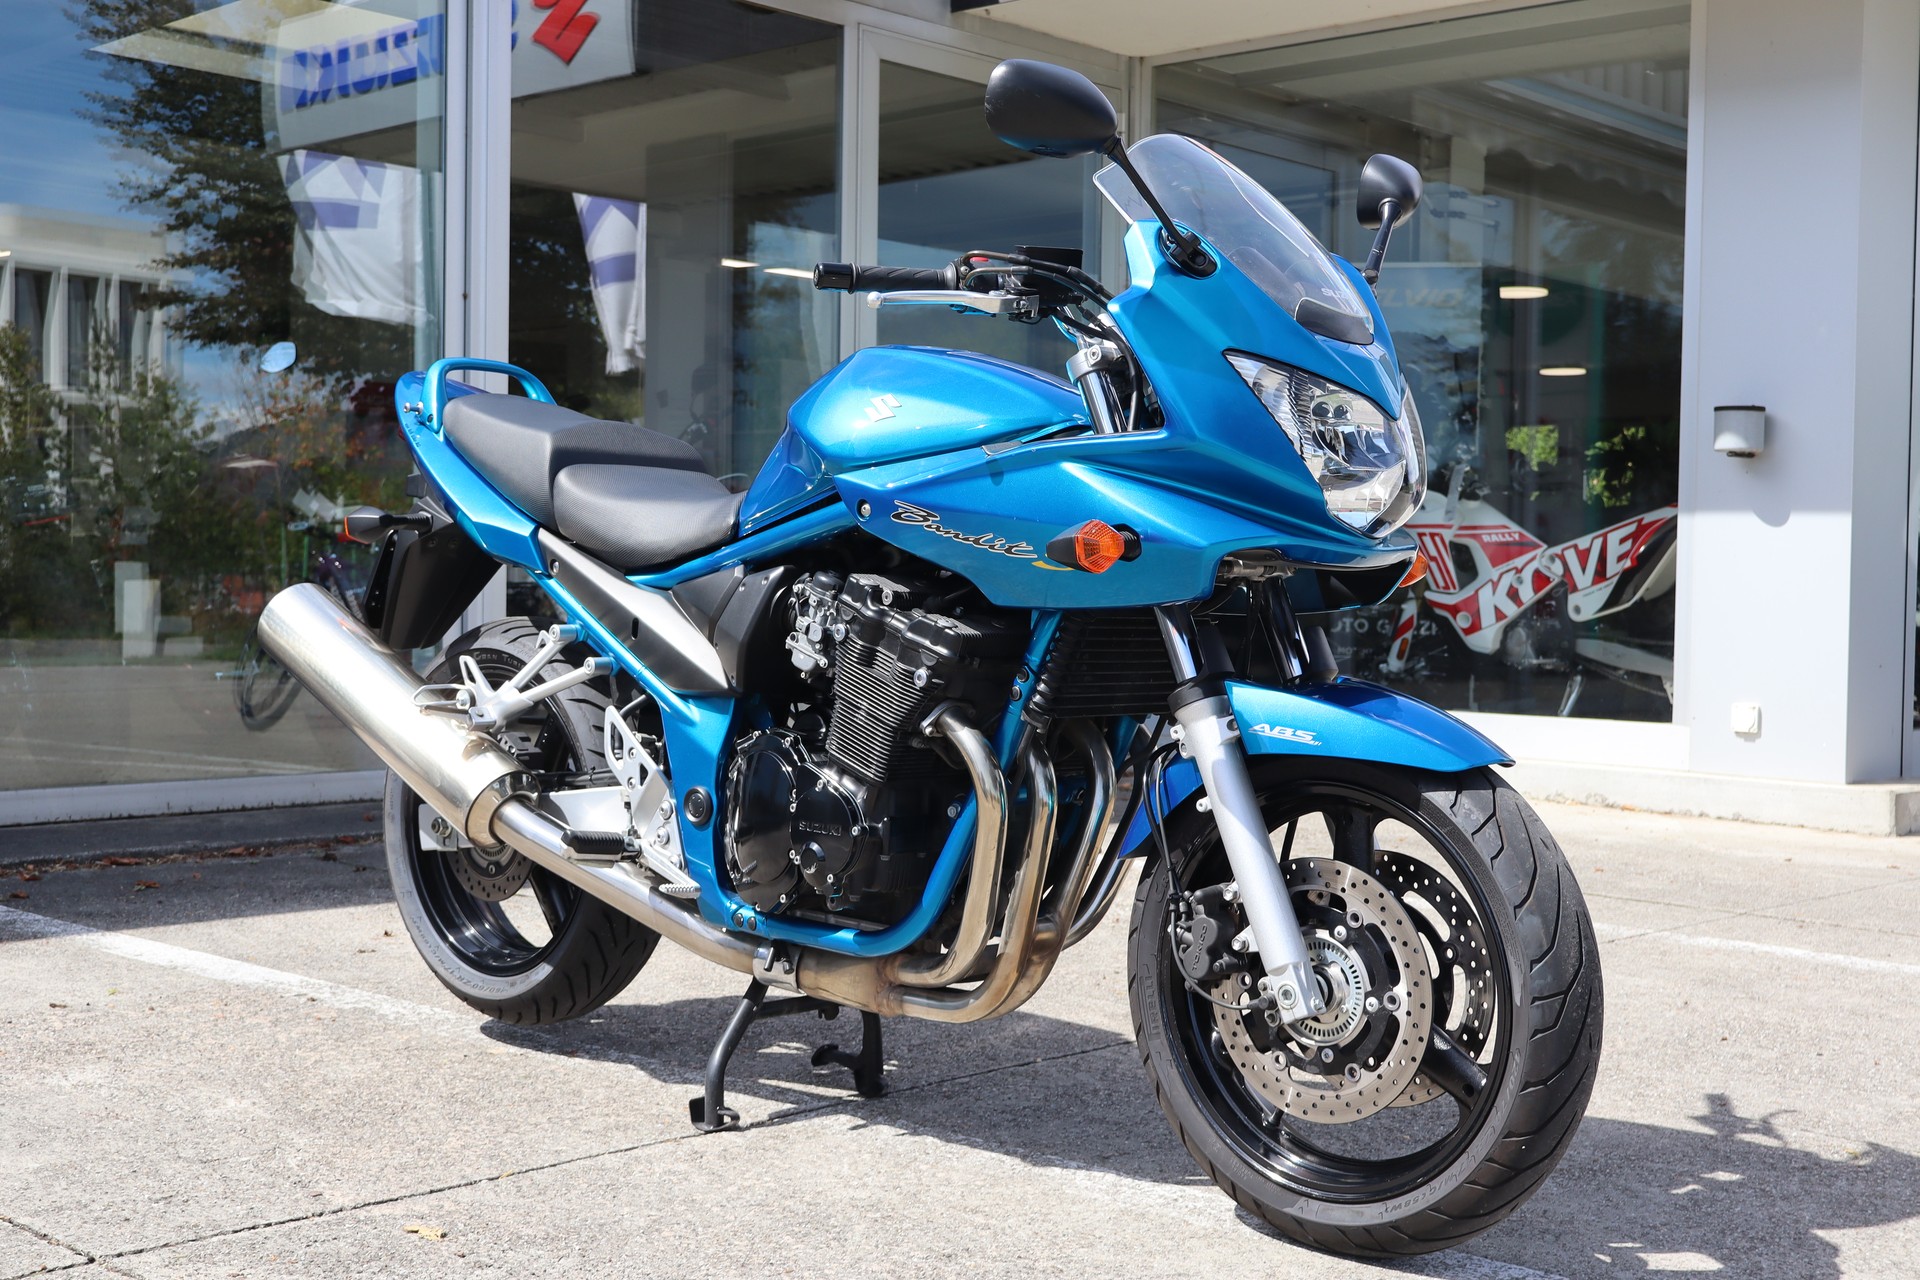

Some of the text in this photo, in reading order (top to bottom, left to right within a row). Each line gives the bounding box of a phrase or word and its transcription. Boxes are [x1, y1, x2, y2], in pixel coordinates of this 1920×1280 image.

[891, 500, 1037, 558] Bandit
[1482, 532, 1520, 543] RALLY
[1477, 519, 1640, 629] KOVE
[1248, 723, 1317, 743] ABS
[799, 821, 841, 836] SUZUKI
[1191, 923, 1208, 972] TOKICO
